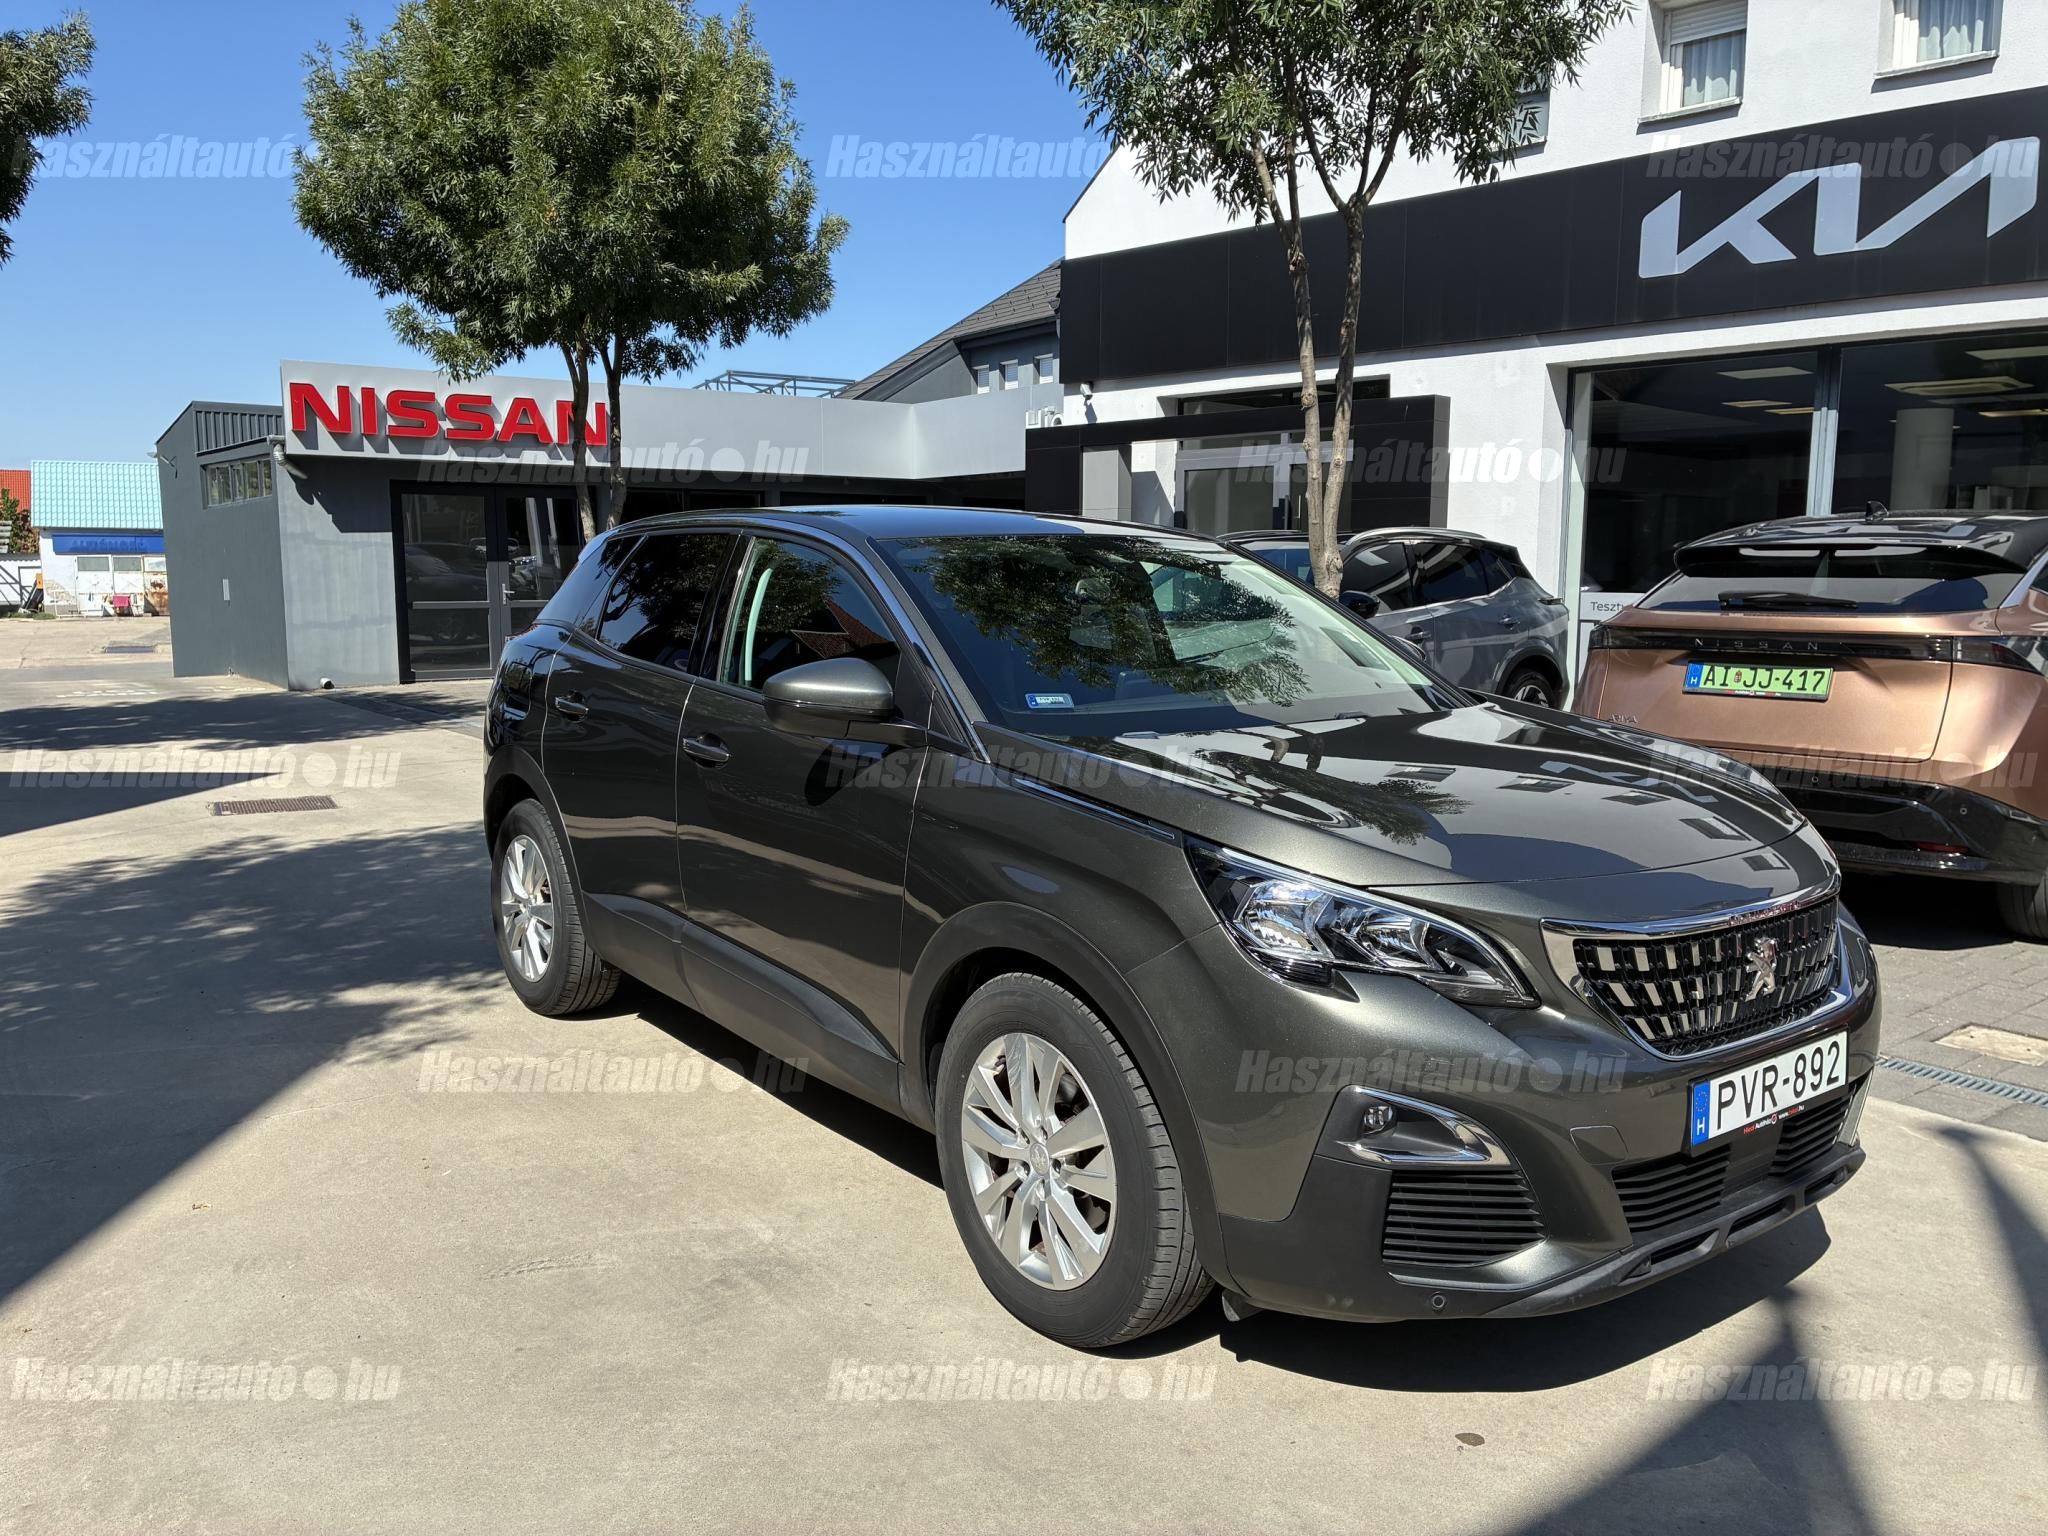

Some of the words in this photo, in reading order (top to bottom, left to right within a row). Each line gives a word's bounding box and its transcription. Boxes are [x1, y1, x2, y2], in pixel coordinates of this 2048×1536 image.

[1638, 136, 2041, 279] KIA
[289, 382, 608, 446] NISSAN
[1695, 638, 1818, 650] NISSAN
[1743, 667, 1825, 692] JJ-417
[1696, 1117, 1705, 1136] H
[1717, 1041, 1840, 1130] PVR-892
